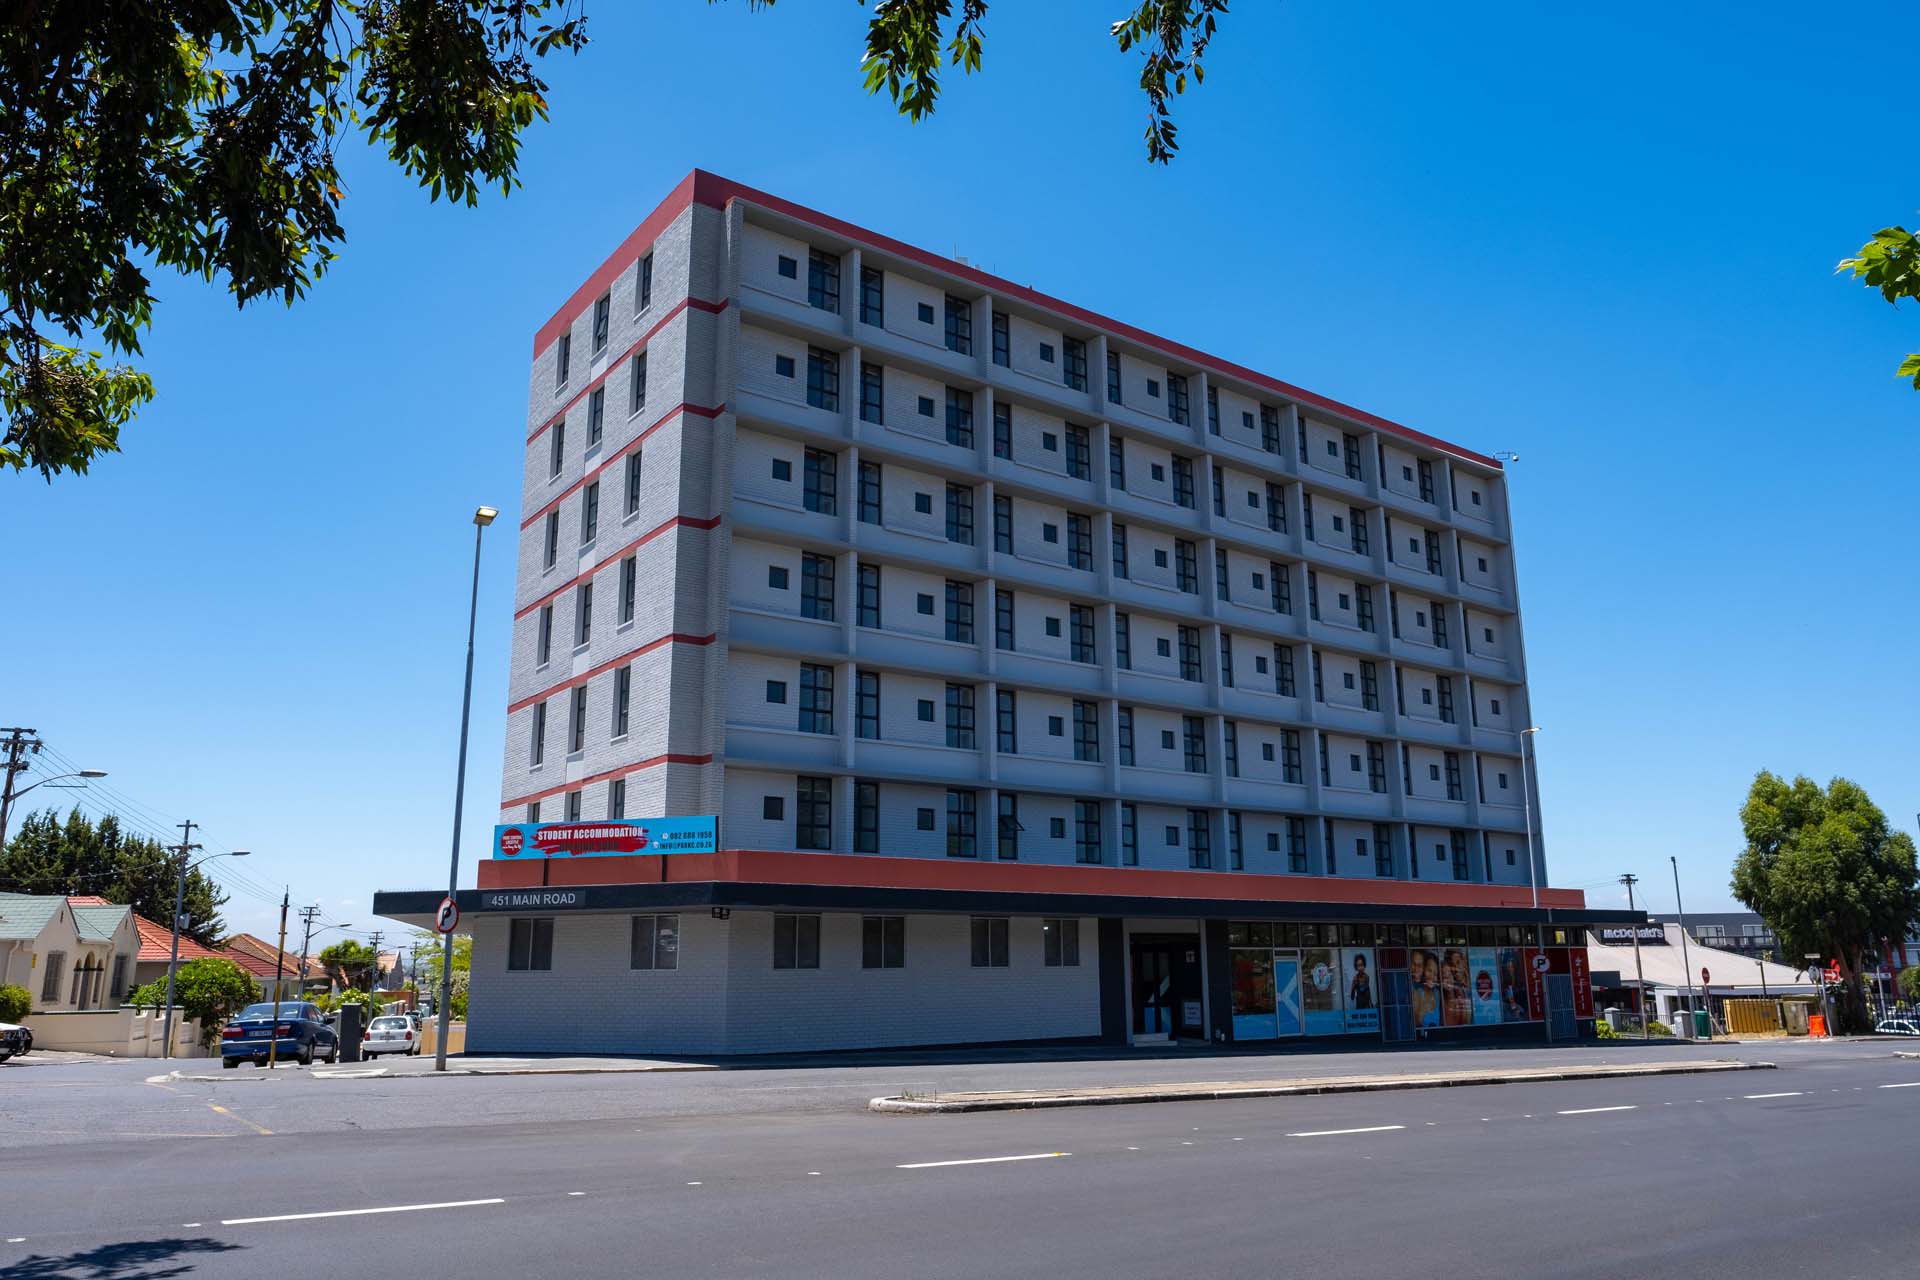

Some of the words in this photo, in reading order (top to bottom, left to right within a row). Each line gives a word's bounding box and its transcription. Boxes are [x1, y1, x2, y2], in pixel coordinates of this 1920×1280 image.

[538, 829, 571, 840] STUDENT
[573, 827, 643, 839] ACCOMMODATION
[491, 896, 509, 906] 451
[512, 894, 541, 906] MAIN
[543, 893, 576, 904] ROAD
[1537, 959, 1546, 969] P
